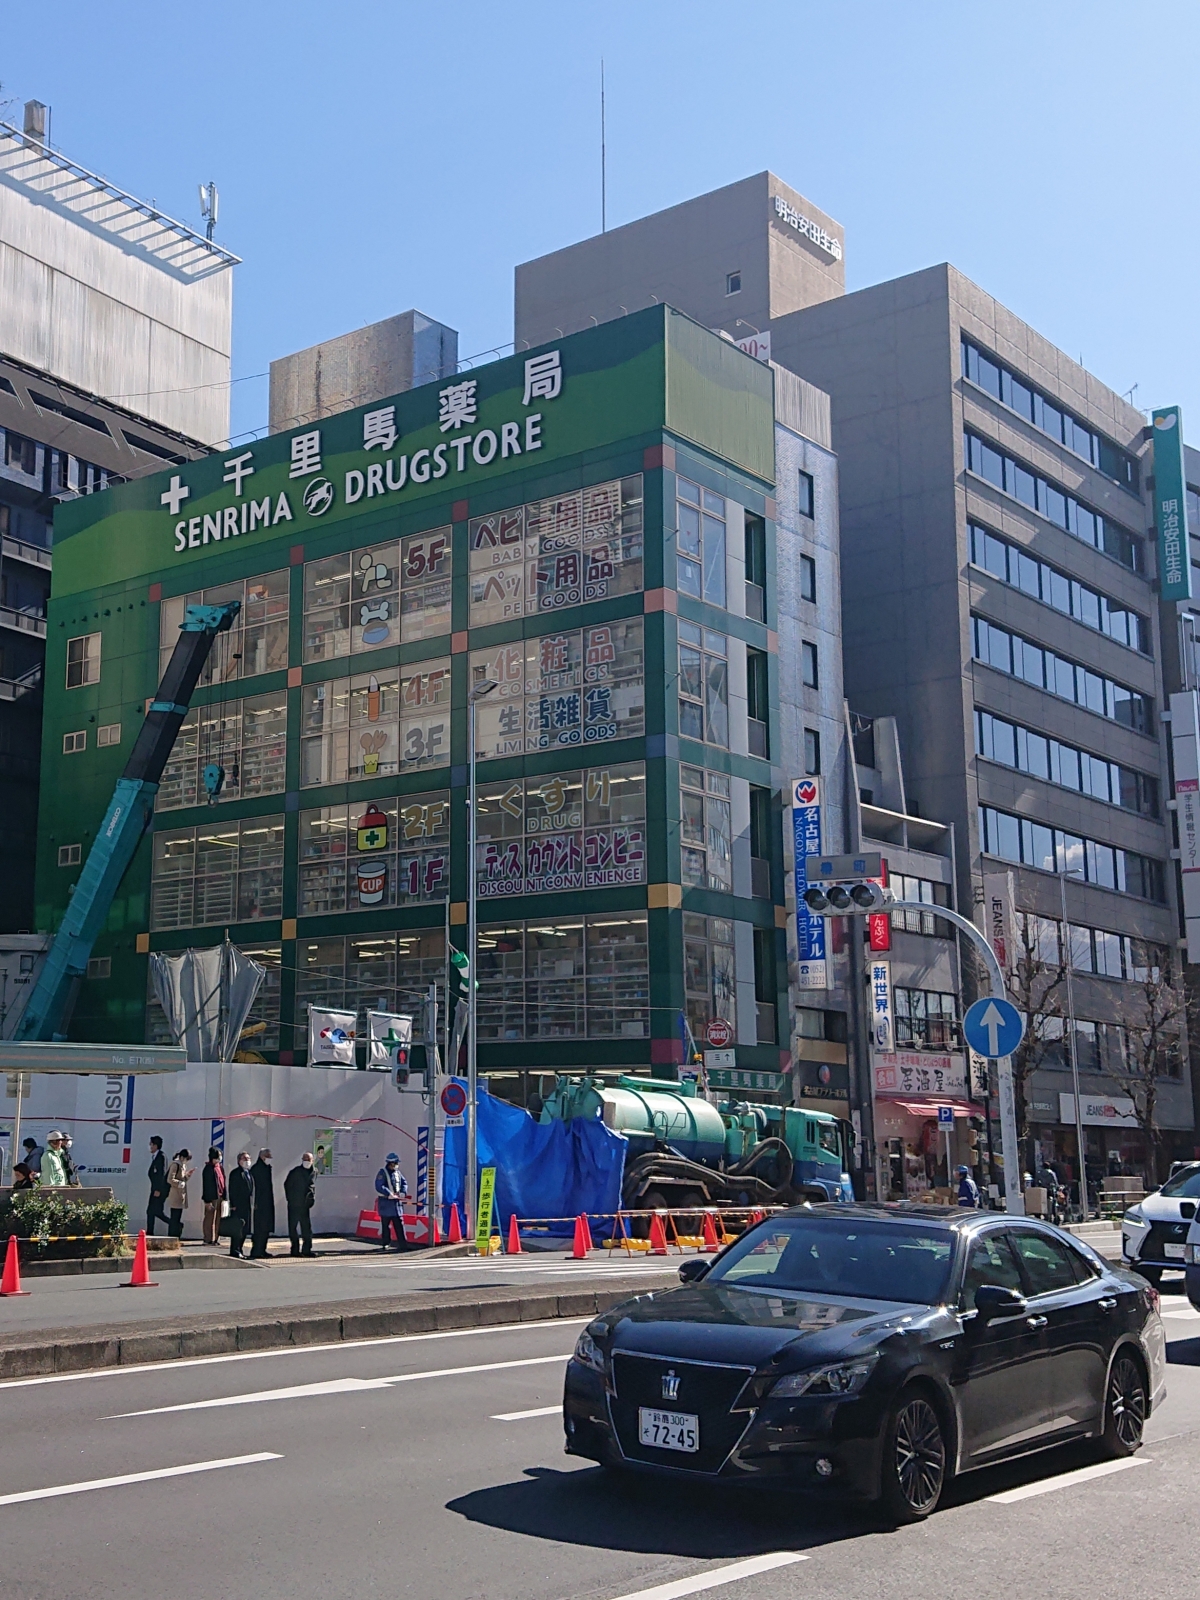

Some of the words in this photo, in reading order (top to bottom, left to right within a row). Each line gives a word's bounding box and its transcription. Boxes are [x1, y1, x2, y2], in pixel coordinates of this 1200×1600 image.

[775, 195, 842, 260] 明治安田生命
[223, 350, 563, 496] 千里馬薬局
[174, 491, 293, 552] SENRIMA
[345, 413, 543, 504] DRUGSTORE
[474, 488, 614, 550] ベビー用品
[406, 537, 446, 579] 5F
[491, 542, 539, 565] BABY
[542, 525, 607, 552] GOODS
[1162, 499, 1182, 584] 明治安田生命
[482, 544, 614, 602] ペット用品
[503, 600, 537, 617] PET
[541, 582, 607, 608] GOODS
[494, 627, 615, 683] 化粧品
[404, 667, 446, 707] 4F
[499, 664, 608, 697] COSMETICS
[498, 687, 612, 737] 生活雑貨
[403, 724, 444, 762] 3F
[496, 735, 549, 755] LIVING
[558, 724, 617, 744] GOODS
[499, 771, 610, 819] くすり
[404, 801, 445, 840] 2F
[527, 812, 582, 833] DRUG
[795, 816, 804, 862] NAGOYA
[361, 878, 383, 893] CUP
[408, 858, 445, 896] 1F
[479, 877, 545, 896] DISCOUNT
[545, 867, 640, 888] CONVENIENCE
[797, 868, 807, 911] FLOWER
[798, 917, 809, 953] HOTEL
[992, 896, 1003, 937] JEANS
[873, 966, 889, 1013] 新世界
[717, 1071, 776, 1089] 千里馬薬局
[900, 1066, 945, 1092] 居酒屋
[941, 1108, 950, 1121] P
[1086, 1104, 1104, 1117] JEANS
[479, 1192, 491, 1236] 歩行者通路
[670, 1415, 685, 1426] 300
